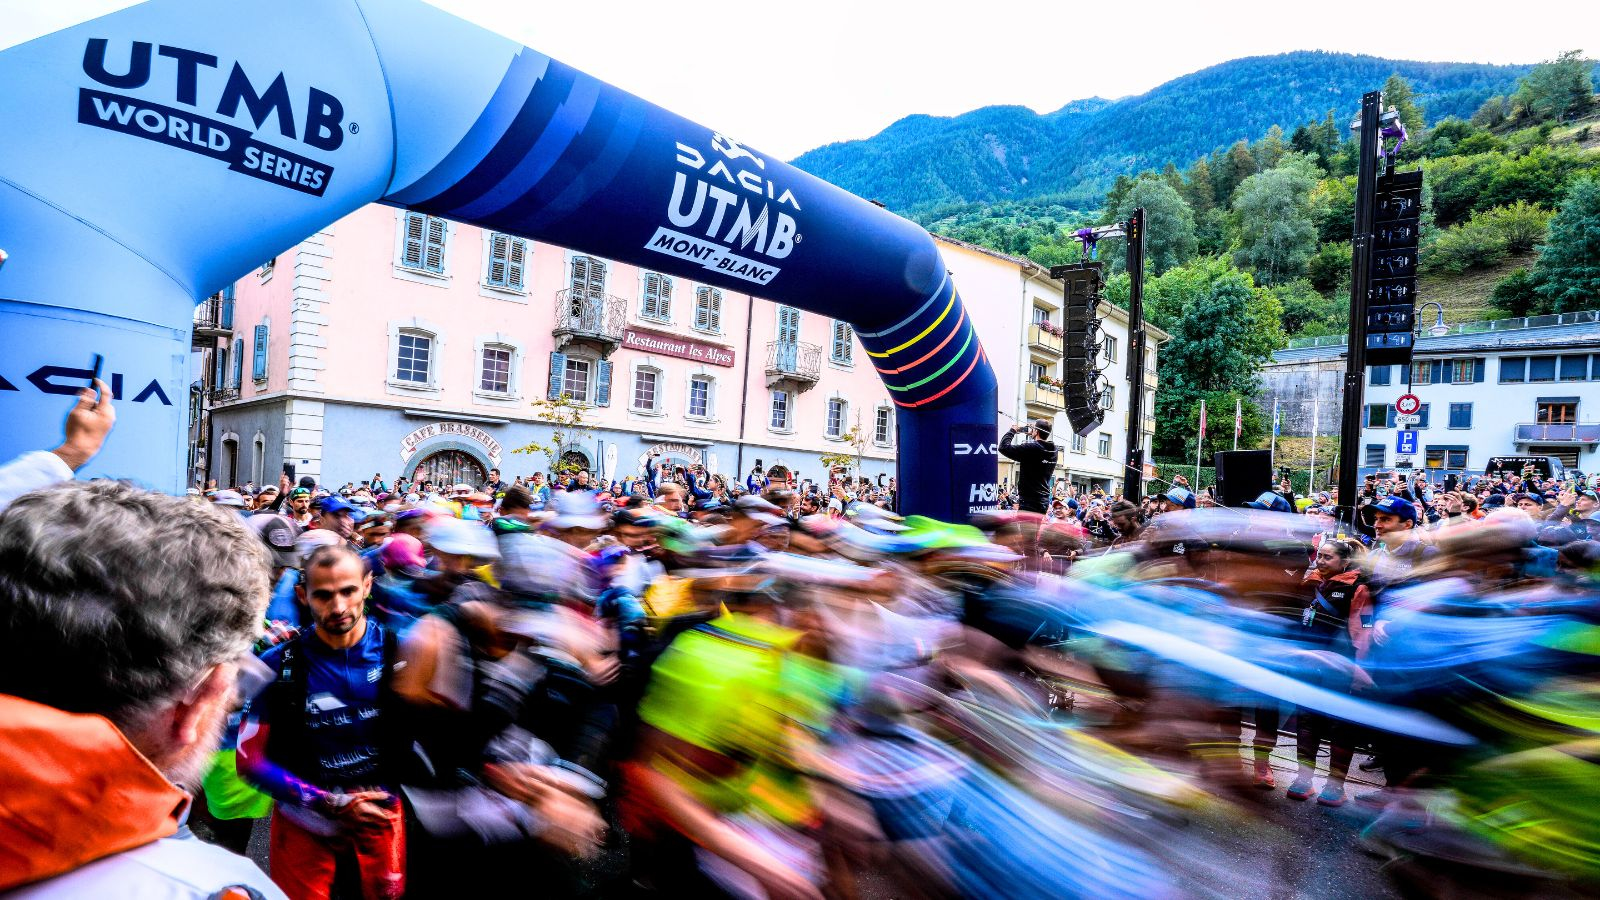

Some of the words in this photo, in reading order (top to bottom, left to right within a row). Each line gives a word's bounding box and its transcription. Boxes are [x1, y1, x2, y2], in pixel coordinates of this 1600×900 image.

[92, 97, 231, 152] WORLD
[242, 146, 326, 190] SERIES
[675, 141, 802, 211] DACIA
[625, 331, 686, 354] Restaurant
[689, 343, 703, 356] les
[705, 348, 732, 364] Alpes
[440, 423, 500, 454] BRASSERIE
[1403, 432, 1413, 444] P
